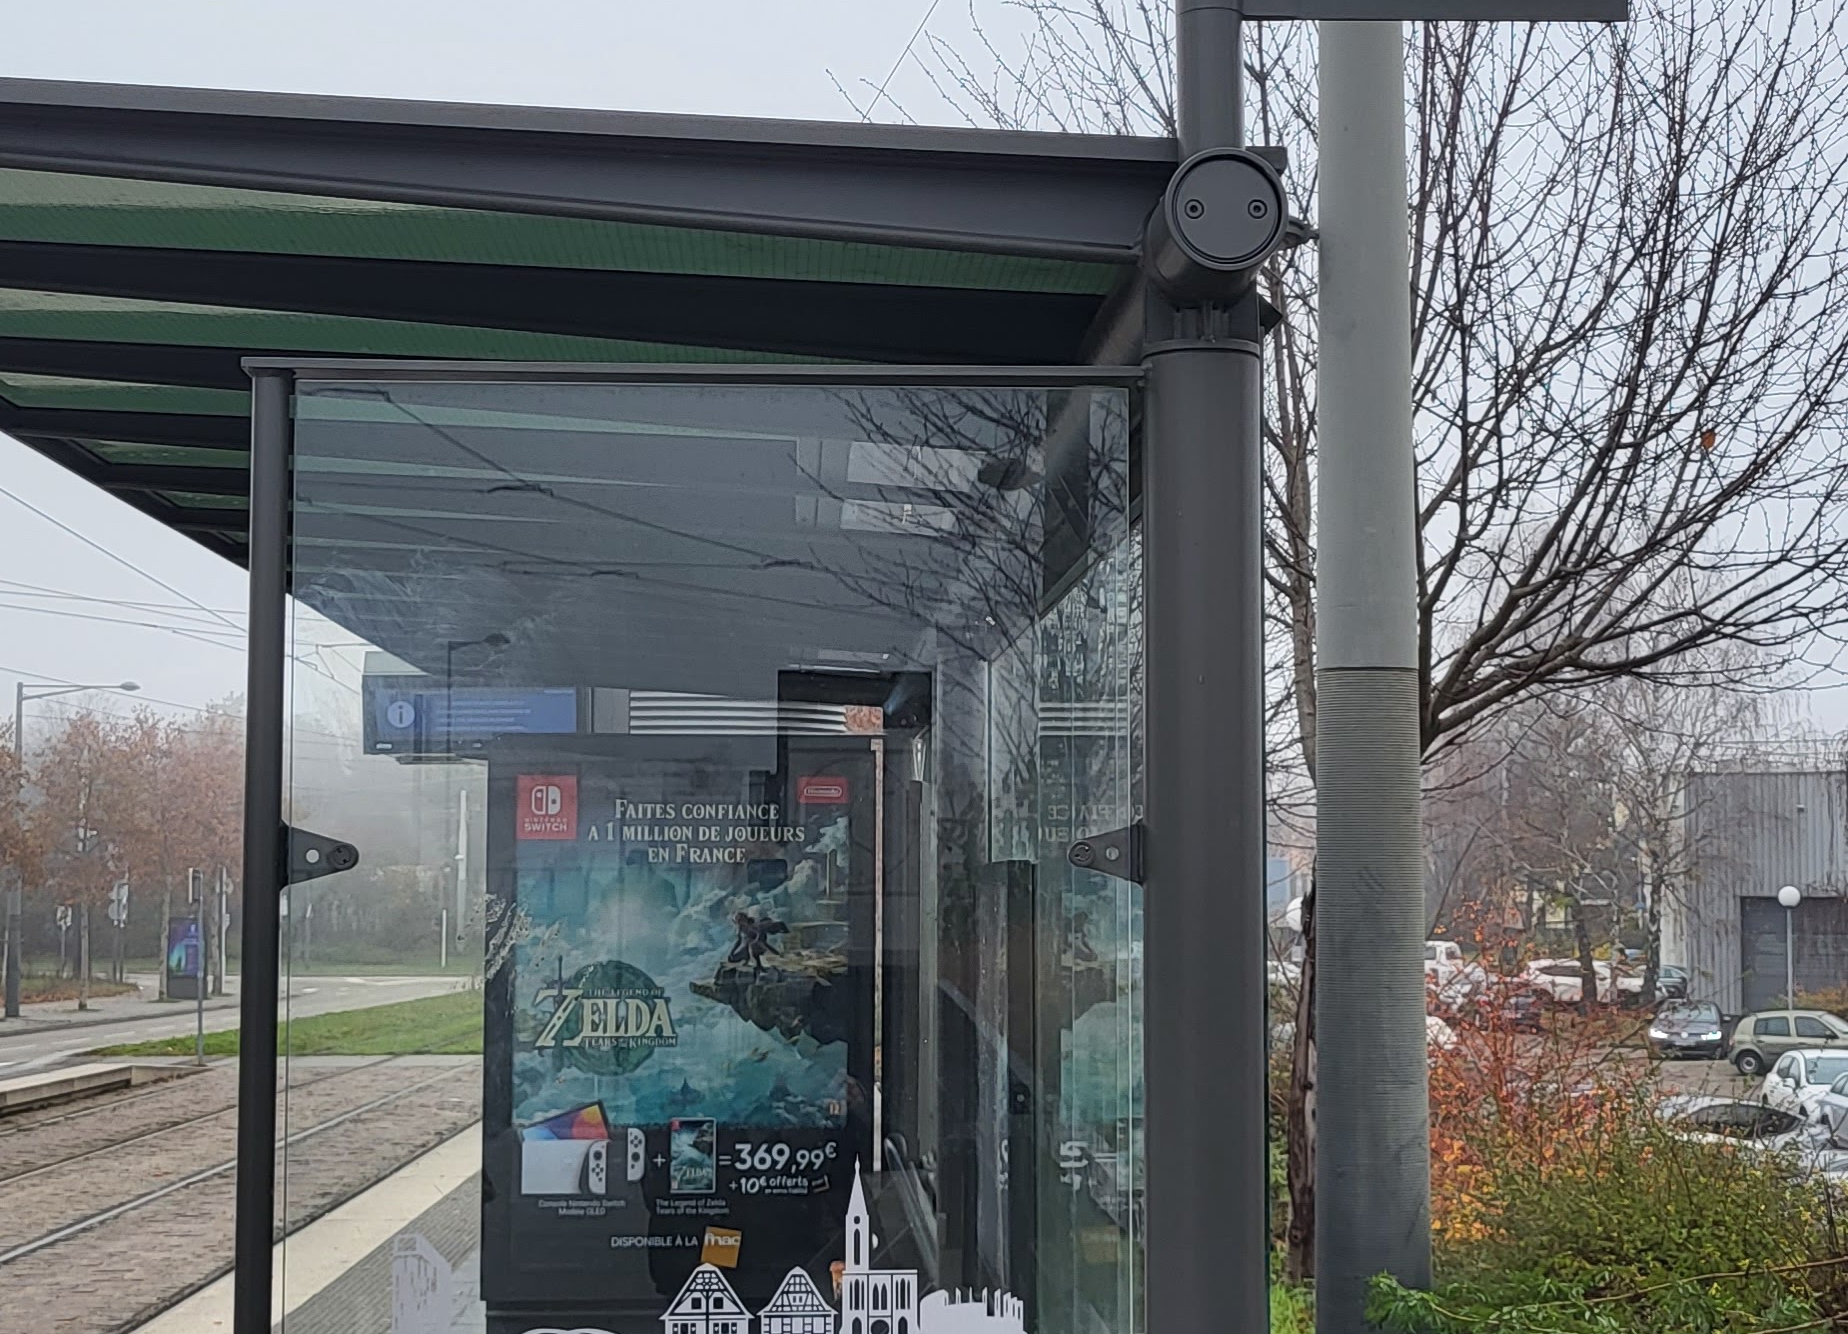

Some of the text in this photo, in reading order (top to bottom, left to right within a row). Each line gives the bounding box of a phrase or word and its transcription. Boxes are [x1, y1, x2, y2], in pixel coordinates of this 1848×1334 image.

[615, 798, 779, 819] FAITES CONFIANCE
[524, 822, 568, 832] SWITCH
[605, 822, 614, 841] 1
[621, 825, 693, 842] MILLION
[698, 826, 720, 841] DE
[724, 826, 805, 843] JOUEURS
[648, 843, 746, 864] EN FRANCE
[534, 988, 677, 1046] ZELDA
[628, 1037, 677, 1049] KINGDOM
[769, 1175, 808, 1187] offerts
[611, 1236, 672, 1247] DISPONIBLE
[685, 1236, 698, 1246] LA
[704, 1233, 741, 1246] fnac
